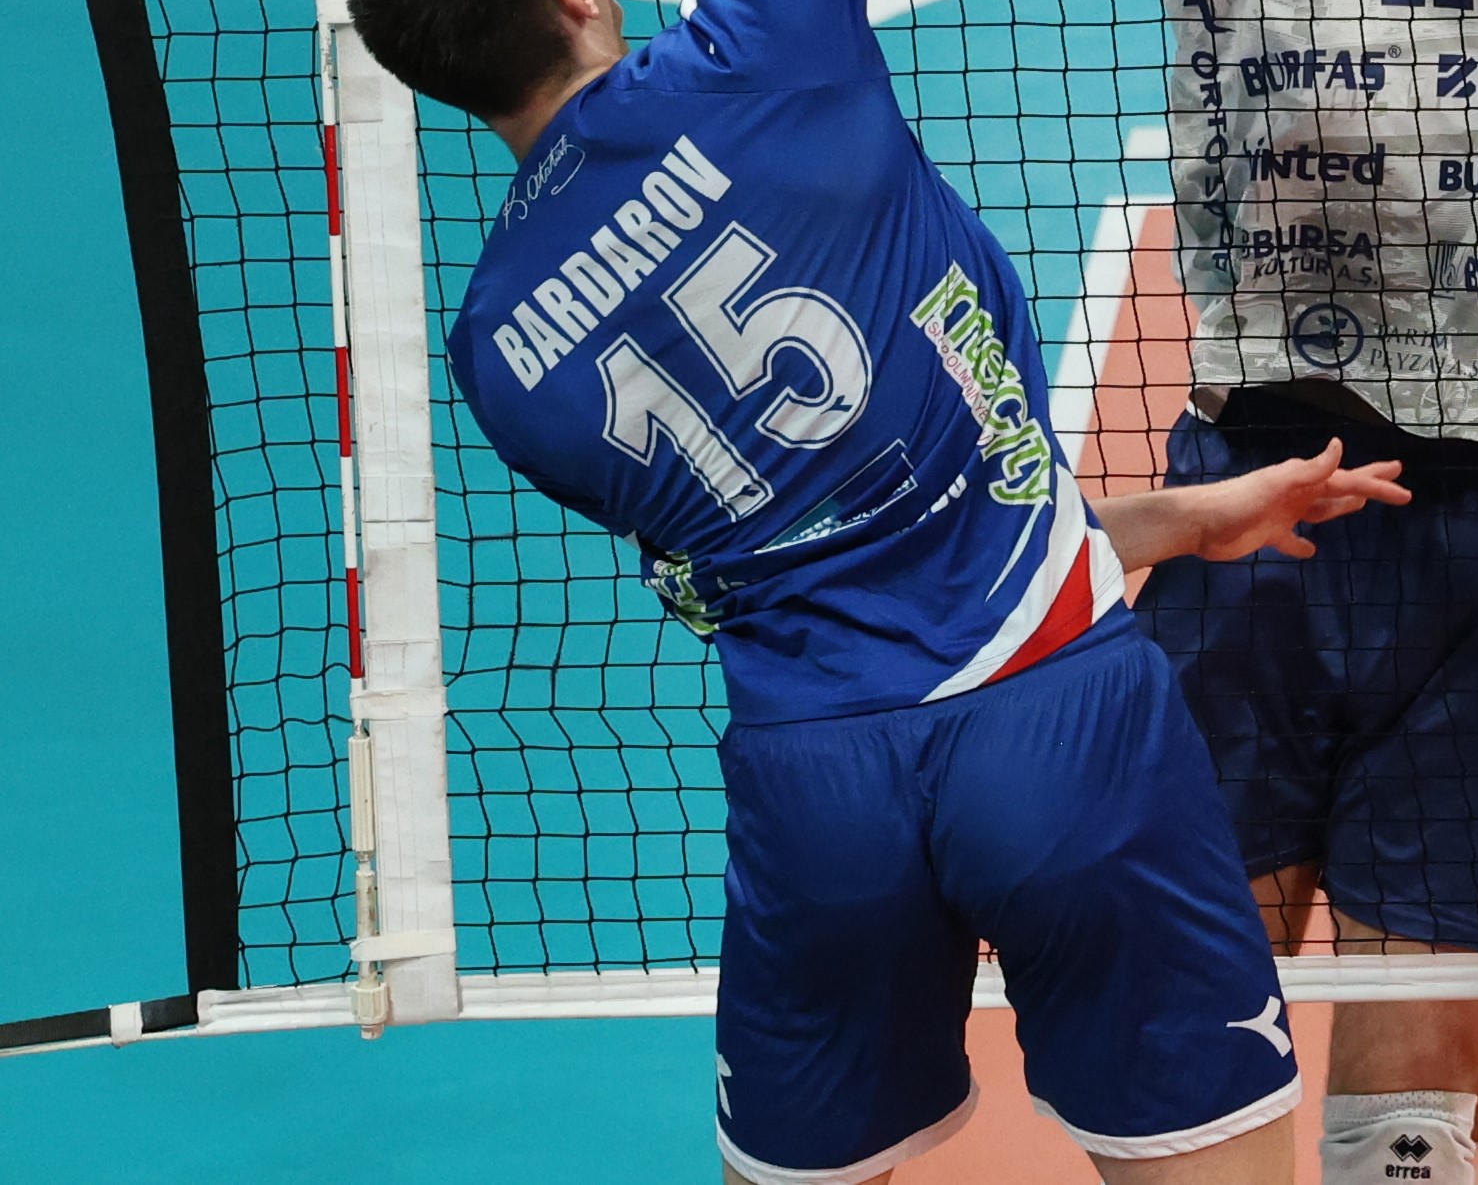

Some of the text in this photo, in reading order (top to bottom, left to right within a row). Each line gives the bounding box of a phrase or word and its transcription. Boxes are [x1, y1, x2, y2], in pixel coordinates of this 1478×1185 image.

[491, 133, 733, 392] BARDAROV
[595, 221, 872, 524] 15
[1253, 224, 1375, 262] BURSA
